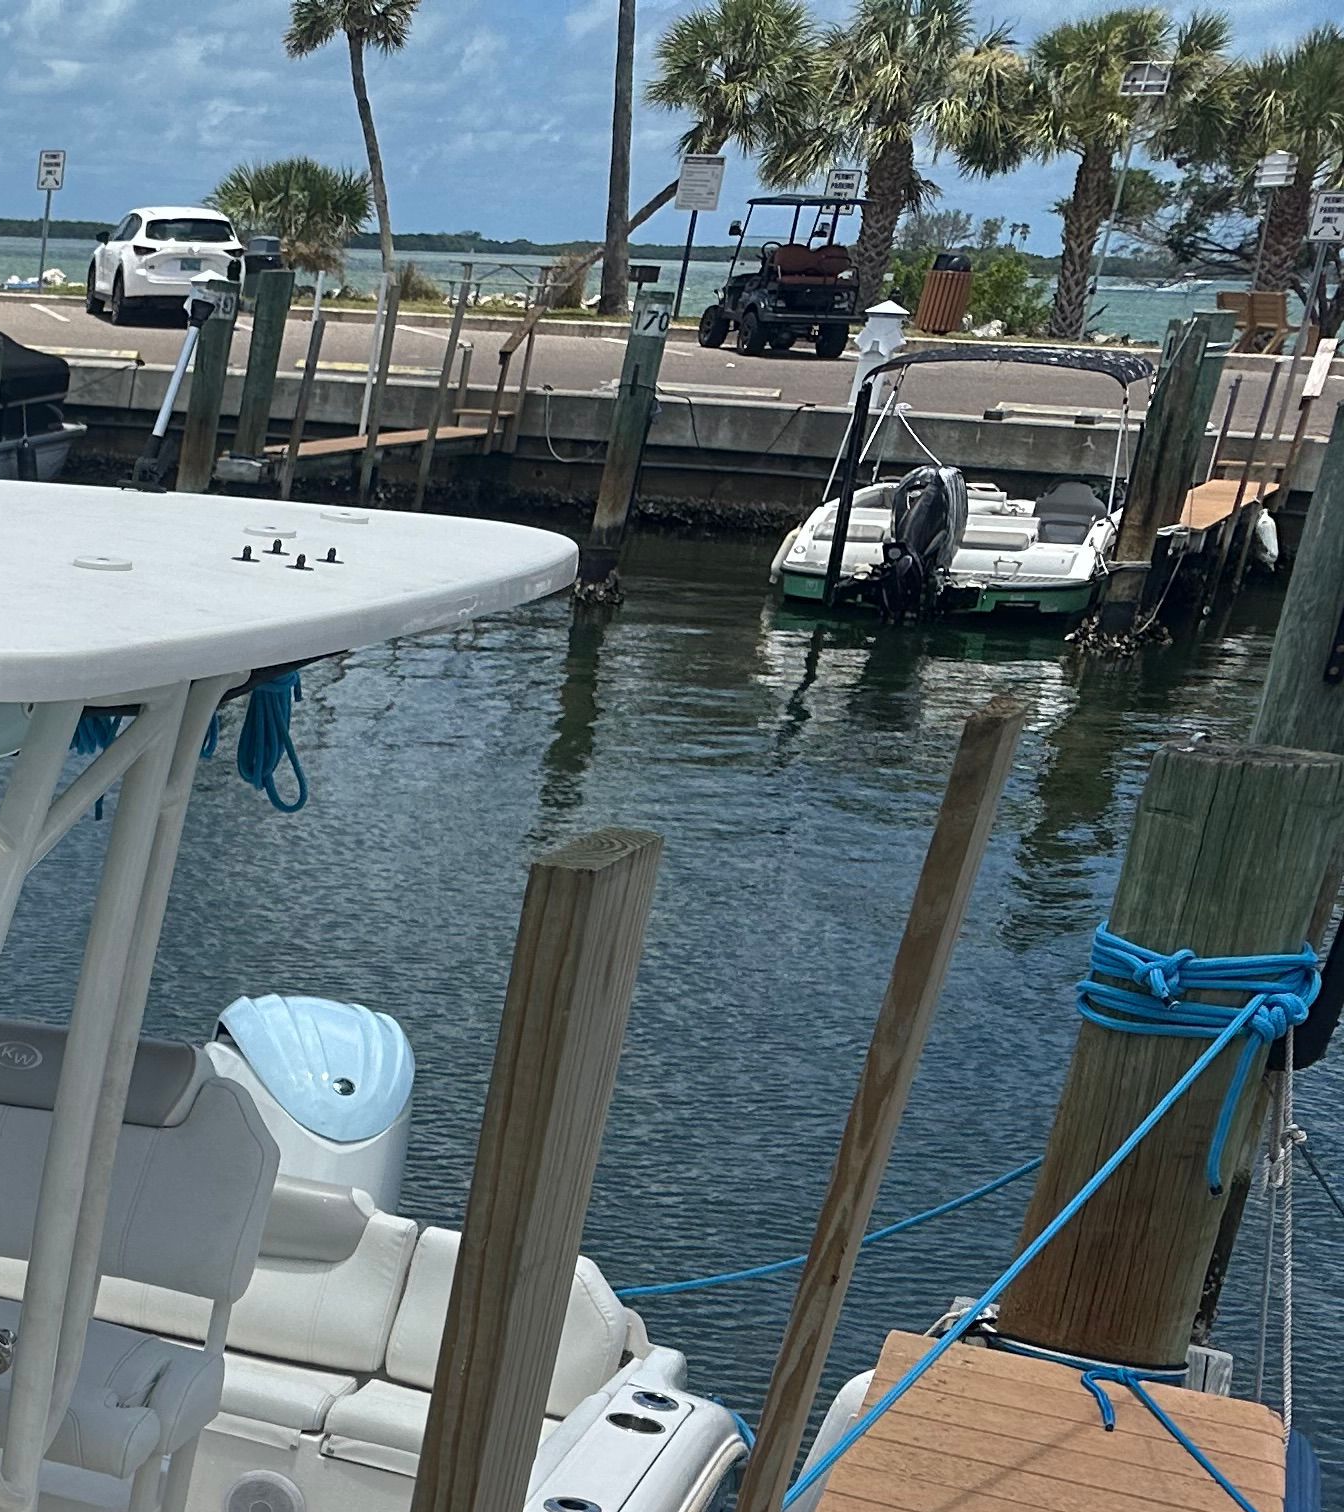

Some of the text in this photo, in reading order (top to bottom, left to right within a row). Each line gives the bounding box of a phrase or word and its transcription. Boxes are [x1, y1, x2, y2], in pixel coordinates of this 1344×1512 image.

[1322, 216, 1339, 224] ONLY
[634, 310, 670, 332] 170
[1, 1045, 36, 1066] KW
